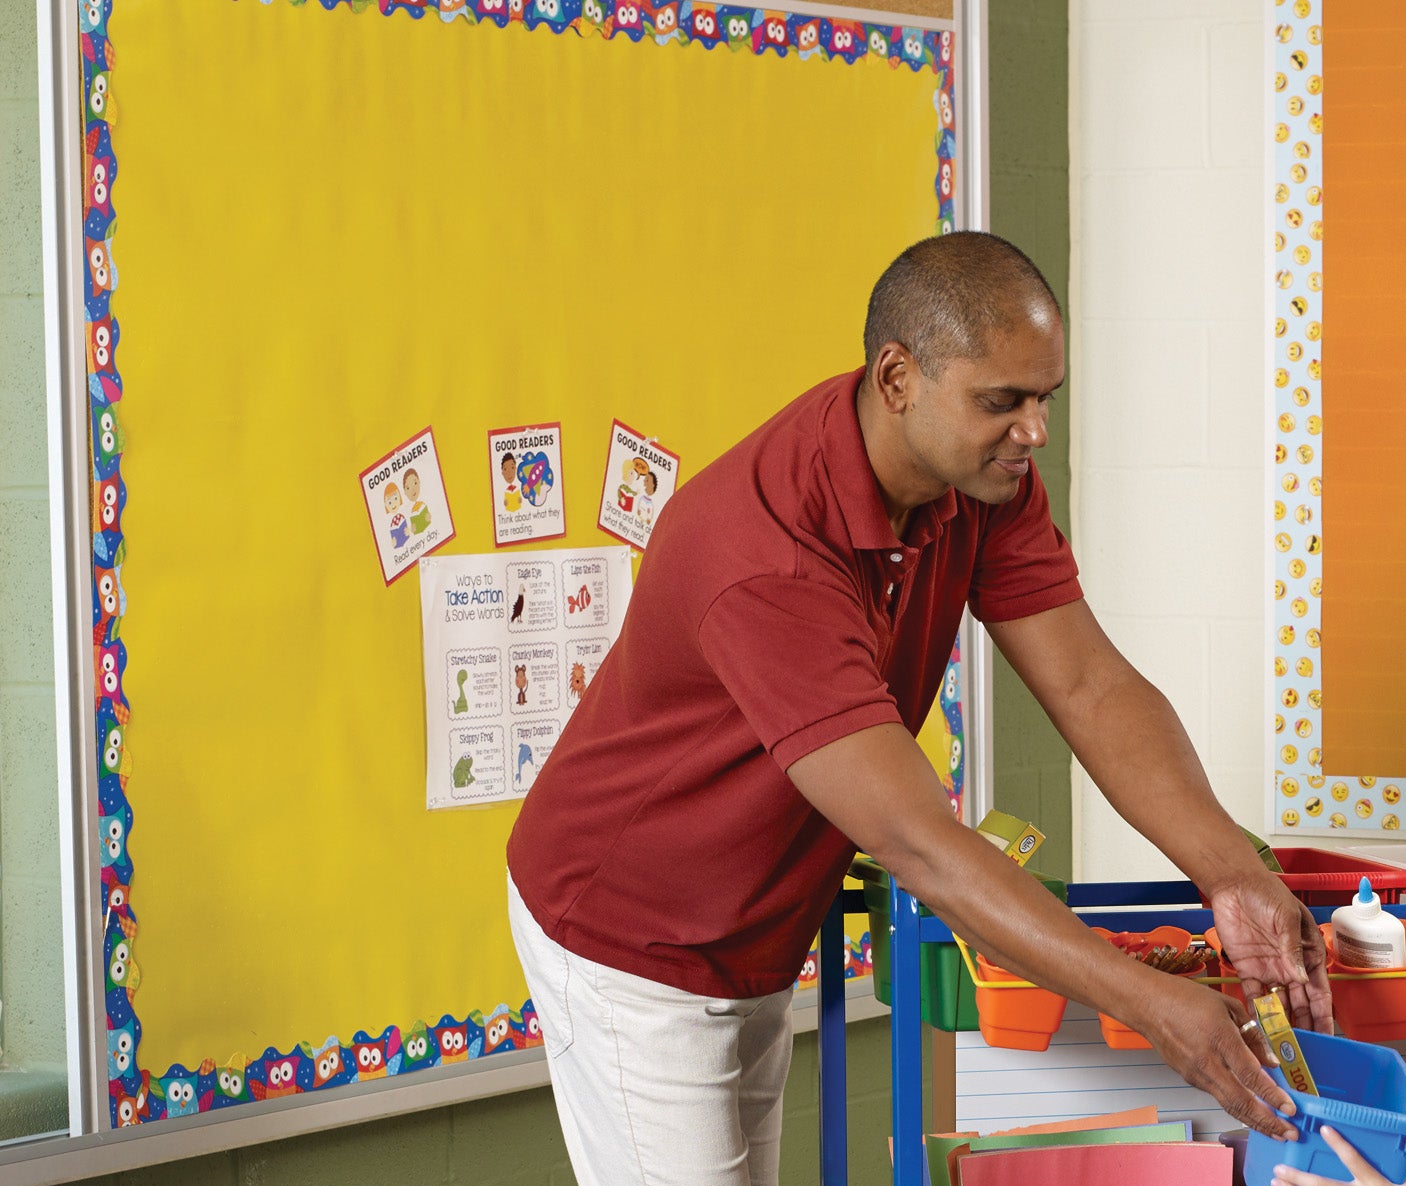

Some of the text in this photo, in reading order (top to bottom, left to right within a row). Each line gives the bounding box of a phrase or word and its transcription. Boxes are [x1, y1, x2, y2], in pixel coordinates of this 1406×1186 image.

[494, 434, 554, 452] GOOD READERS
[616, 432, 672, 473] GOOD READERS
[368, 441, 428, 490] GOOD READERS
[497, 506, 561, 527] Think about what they
[605, 500, 623, 519] Share
[623, 511, 636, 527] and
[635, 517, 647, 534] talk
[499, 526, 509, 537] are
[603, 514, 617, 528] what
[616, 521, 630, 537] they
[393, 528, 441, 568] Read every day.
[456, 574, 493, 588] Ways to
[518, 568, 542, 579] Eagle Eye
[445, 589, 503, 606] Take Action
[445, 607, 504, 622] & Solve Words
[451, 654, 497, 666] Stretchy Snake
[512, 649, 554, 661] Chunky Monkey
[459, 732, 493, 745] Skippy Frog
[517, 726, 553, 739] Flippy Dolphin
